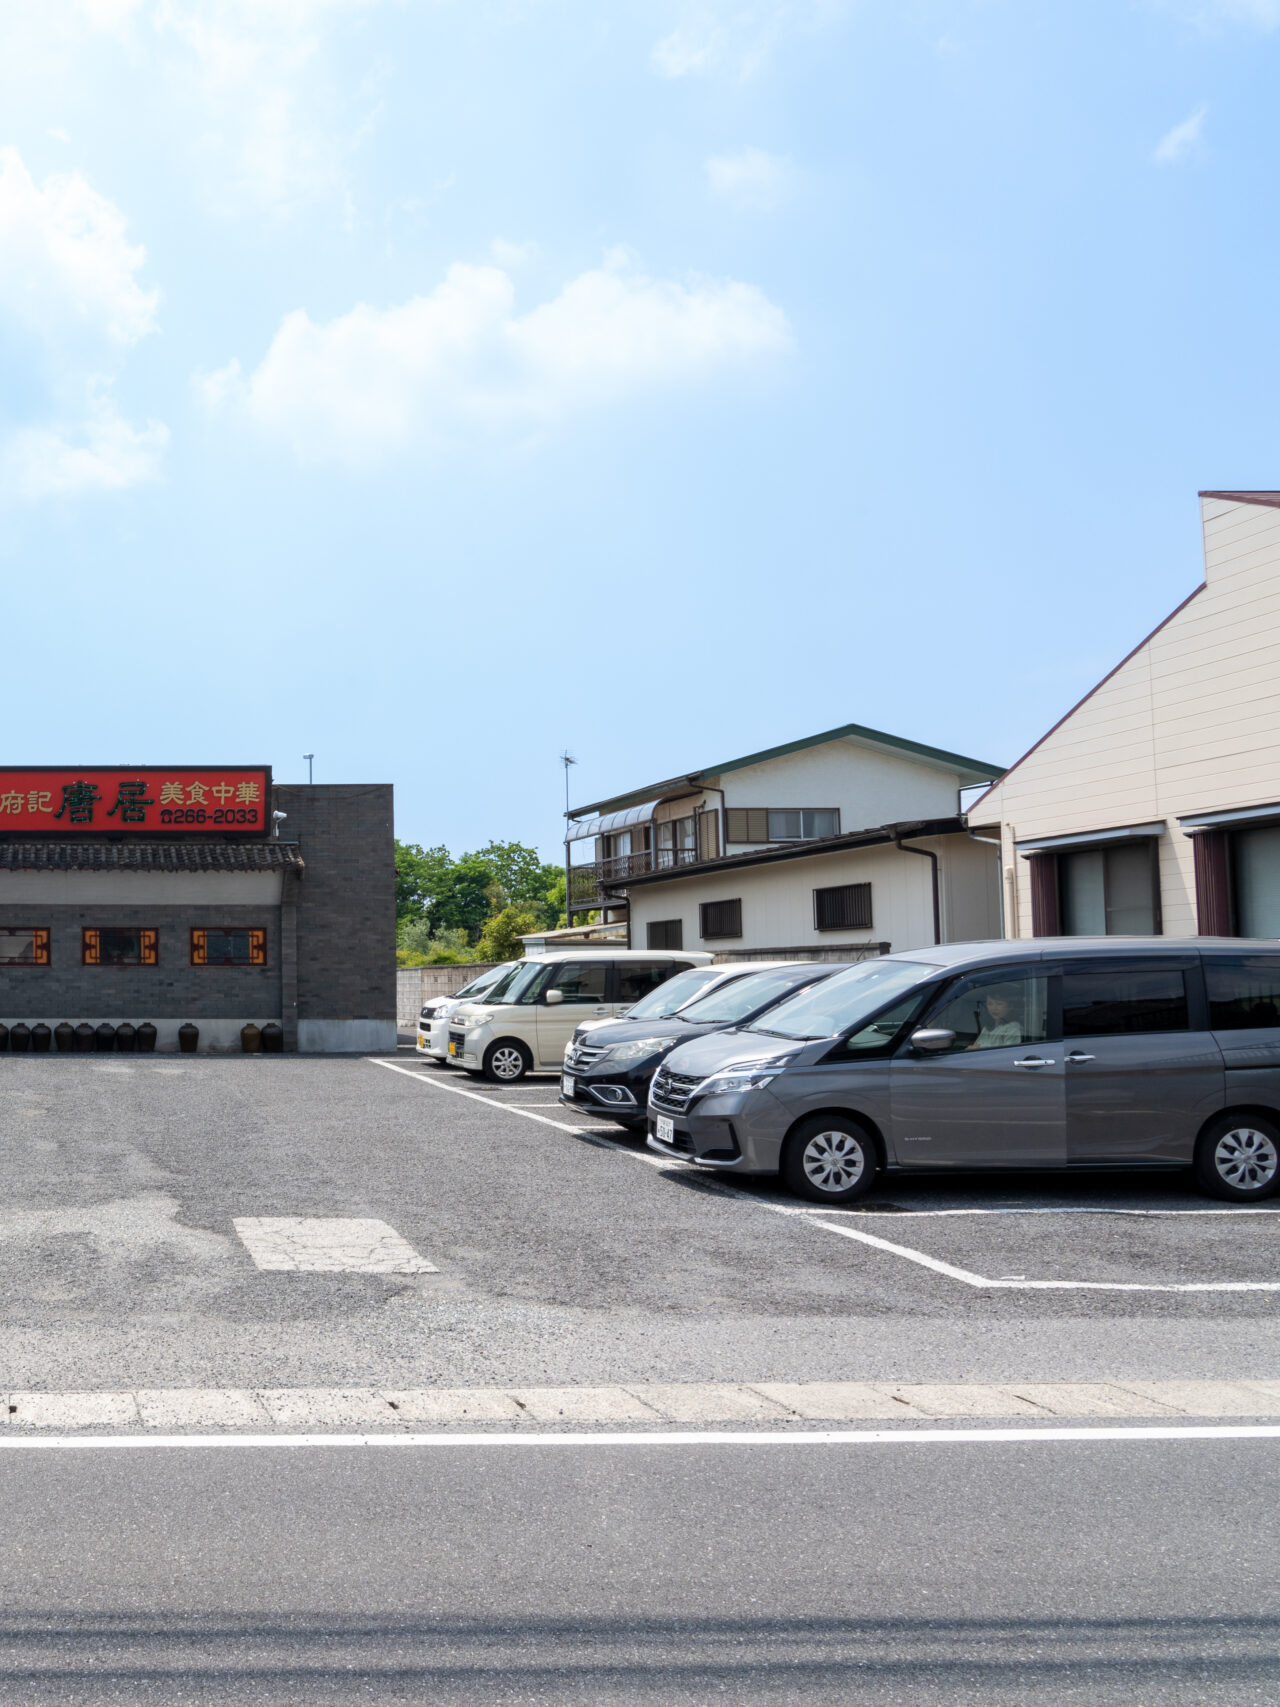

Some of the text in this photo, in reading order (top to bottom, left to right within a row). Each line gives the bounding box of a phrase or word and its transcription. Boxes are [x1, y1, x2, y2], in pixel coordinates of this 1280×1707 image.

[53, 780, 155, 823] 唐居
[160, 781, 260, 805] 美食中華
